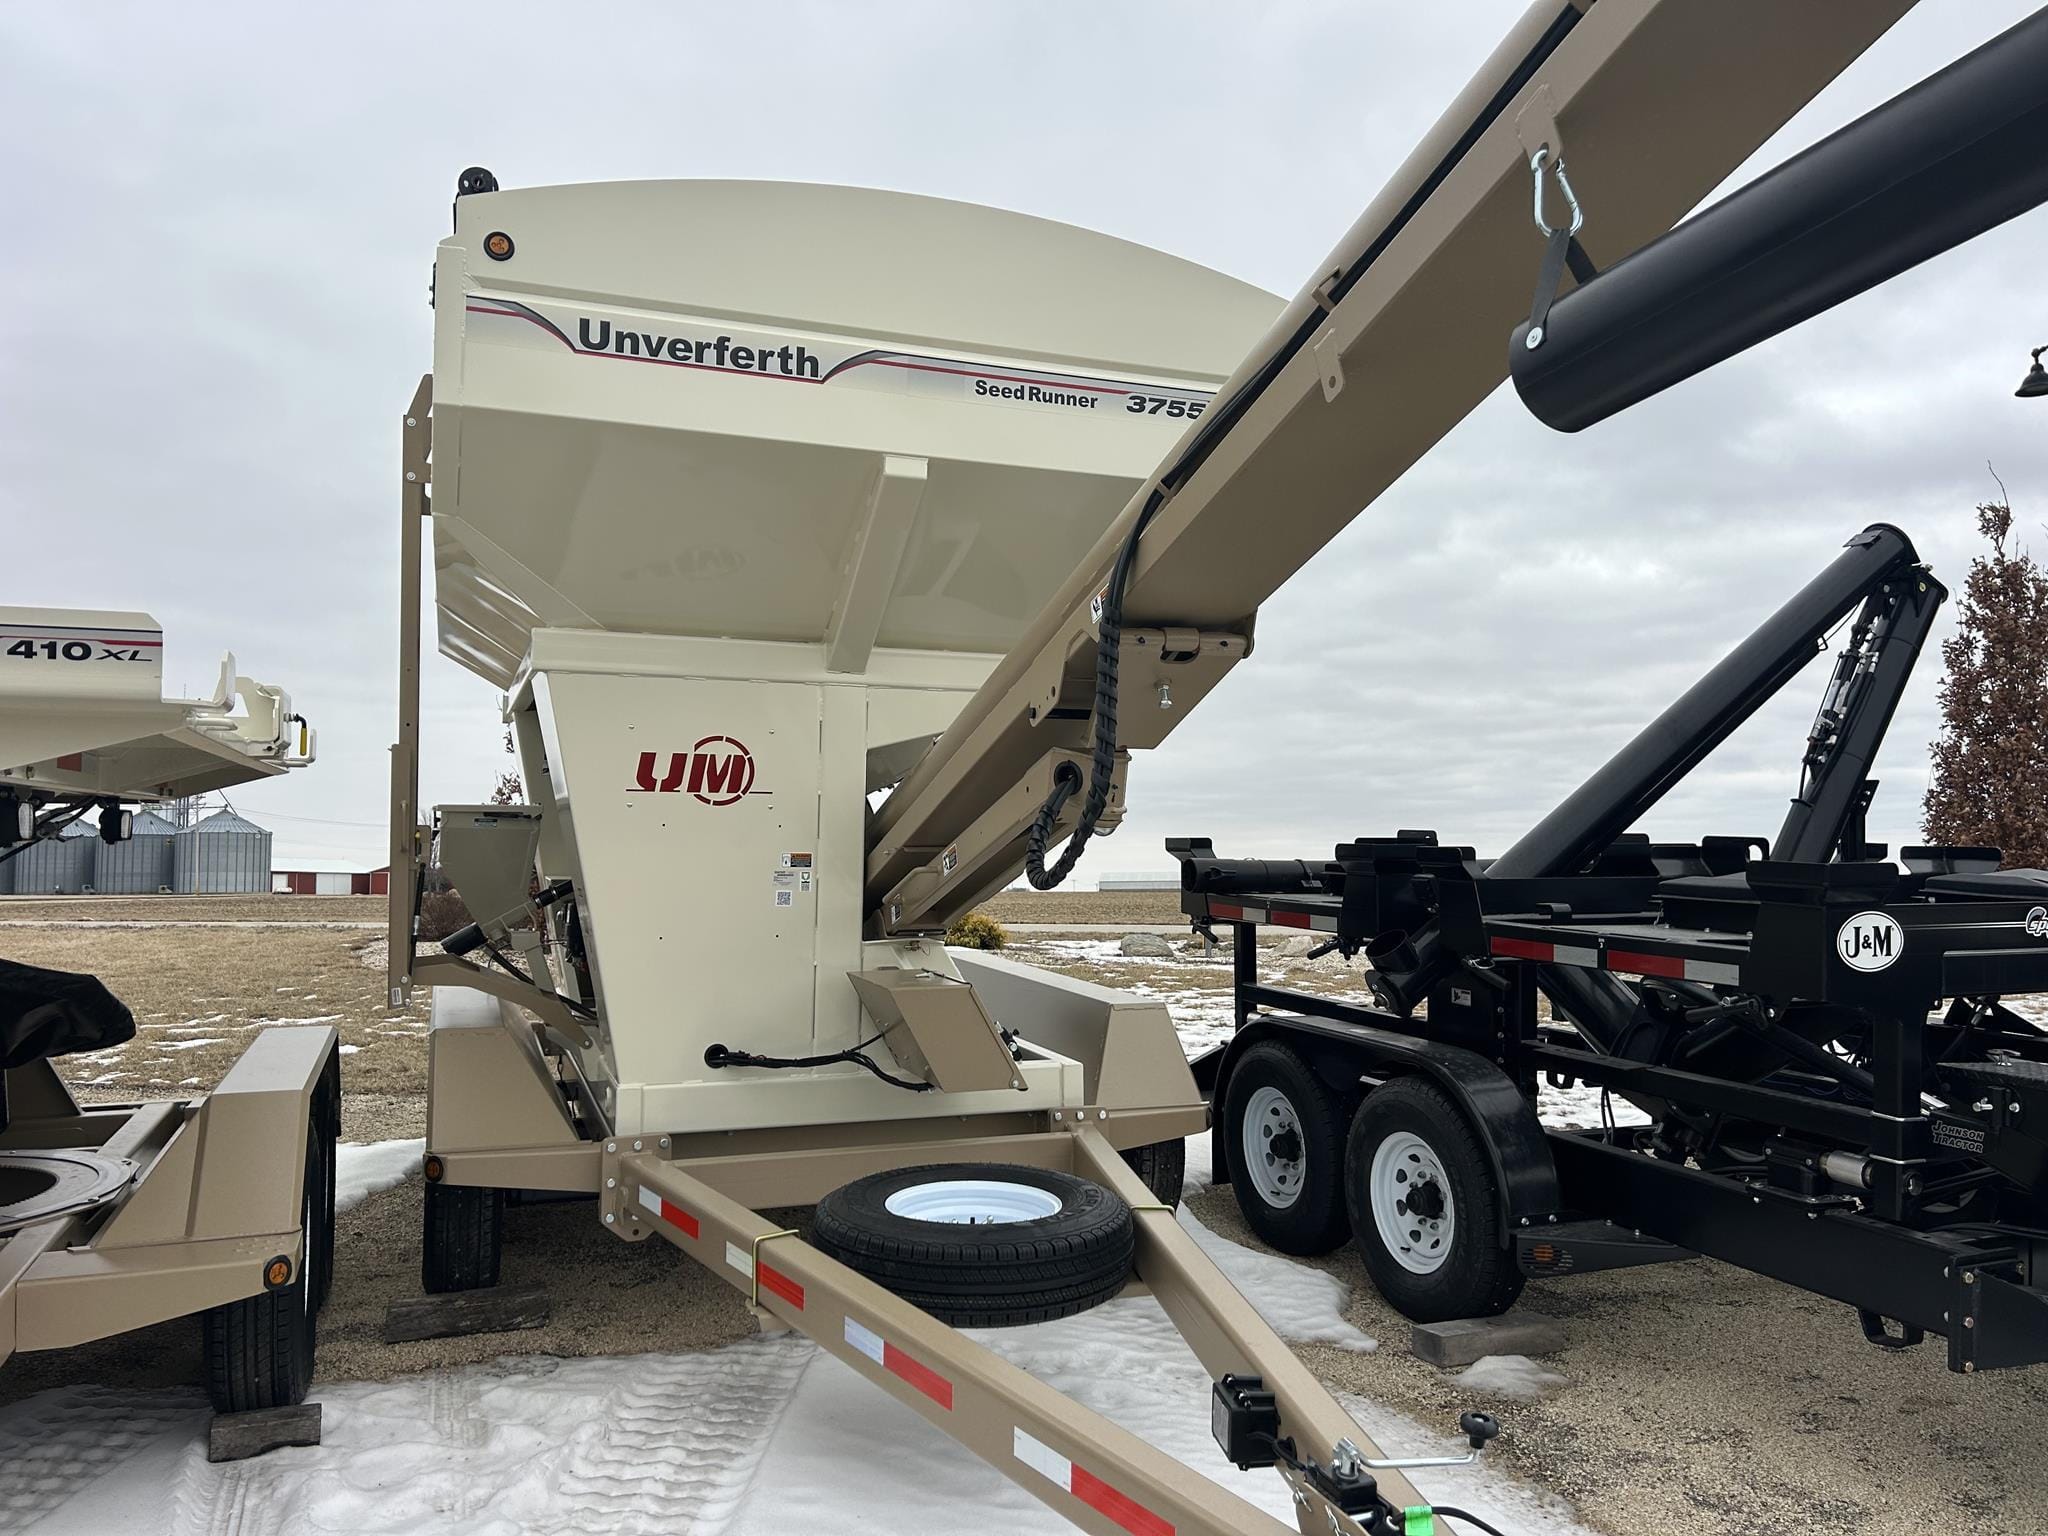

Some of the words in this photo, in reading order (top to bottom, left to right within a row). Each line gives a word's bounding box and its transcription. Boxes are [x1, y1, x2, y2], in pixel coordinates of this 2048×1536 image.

[578, 318, 820, 379] Unverferth
[975, 380, 1025, 401] Seed
[1028, 386, 1099, 409] Runner
[1126, 395, 1207, 420] 3755
[1843, 925, 1893, 959] J&M
